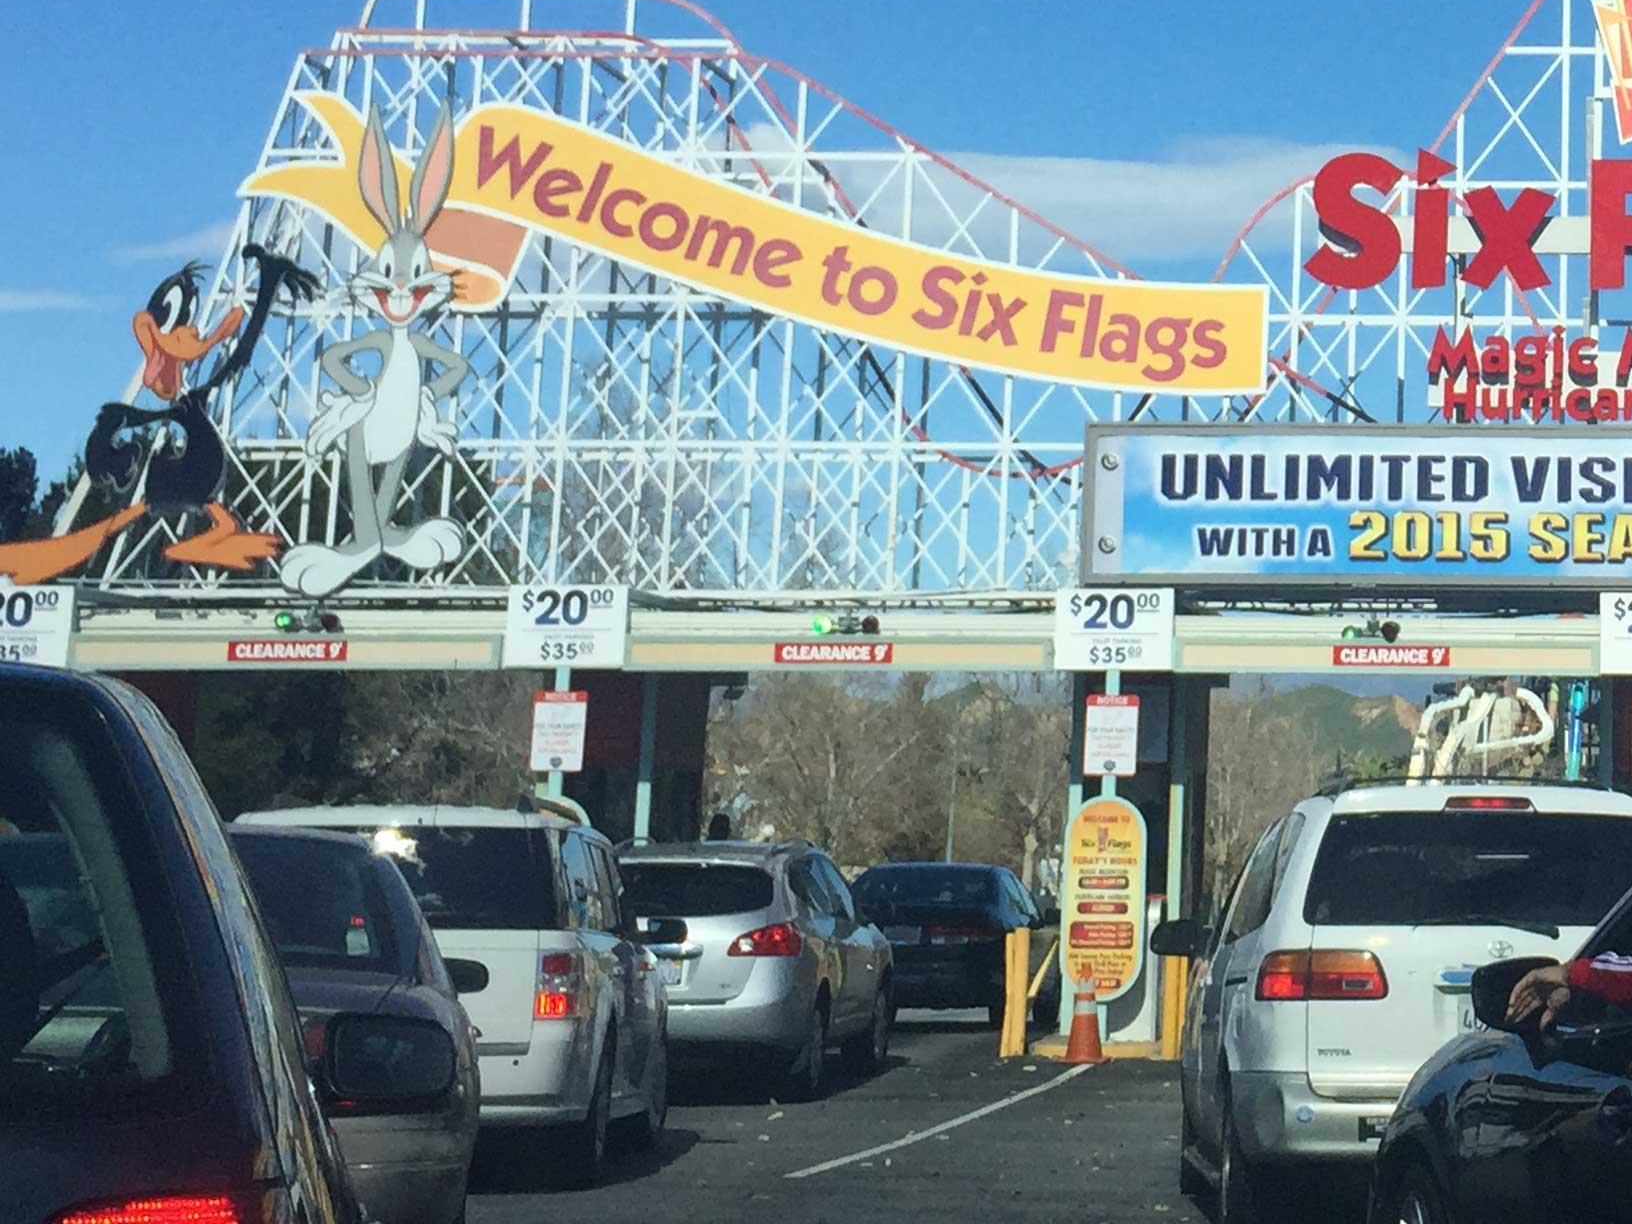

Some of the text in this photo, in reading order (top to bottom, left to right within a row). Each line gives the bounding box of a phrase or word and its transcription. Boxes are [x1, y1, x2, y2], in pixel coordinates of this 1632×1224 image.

[1303, 147, 1557, 292] Six
[477, 124, 1228, 383] Welcome to Six Flags
[1427, 323, 1599, 388] Magic
[1159, 453, 1491, 505] UNLIMITED
[1196, 526, 1301, 558] WITH
[1306, 526, 1333, 558] A
[1347, 510, 1510, 562] 2015
[235, 643, 326, 659] CLEARANCE
[781, 645, 872, 661] CLEARANCE
[1340, 648, 1429, 664] CLEARANCE
